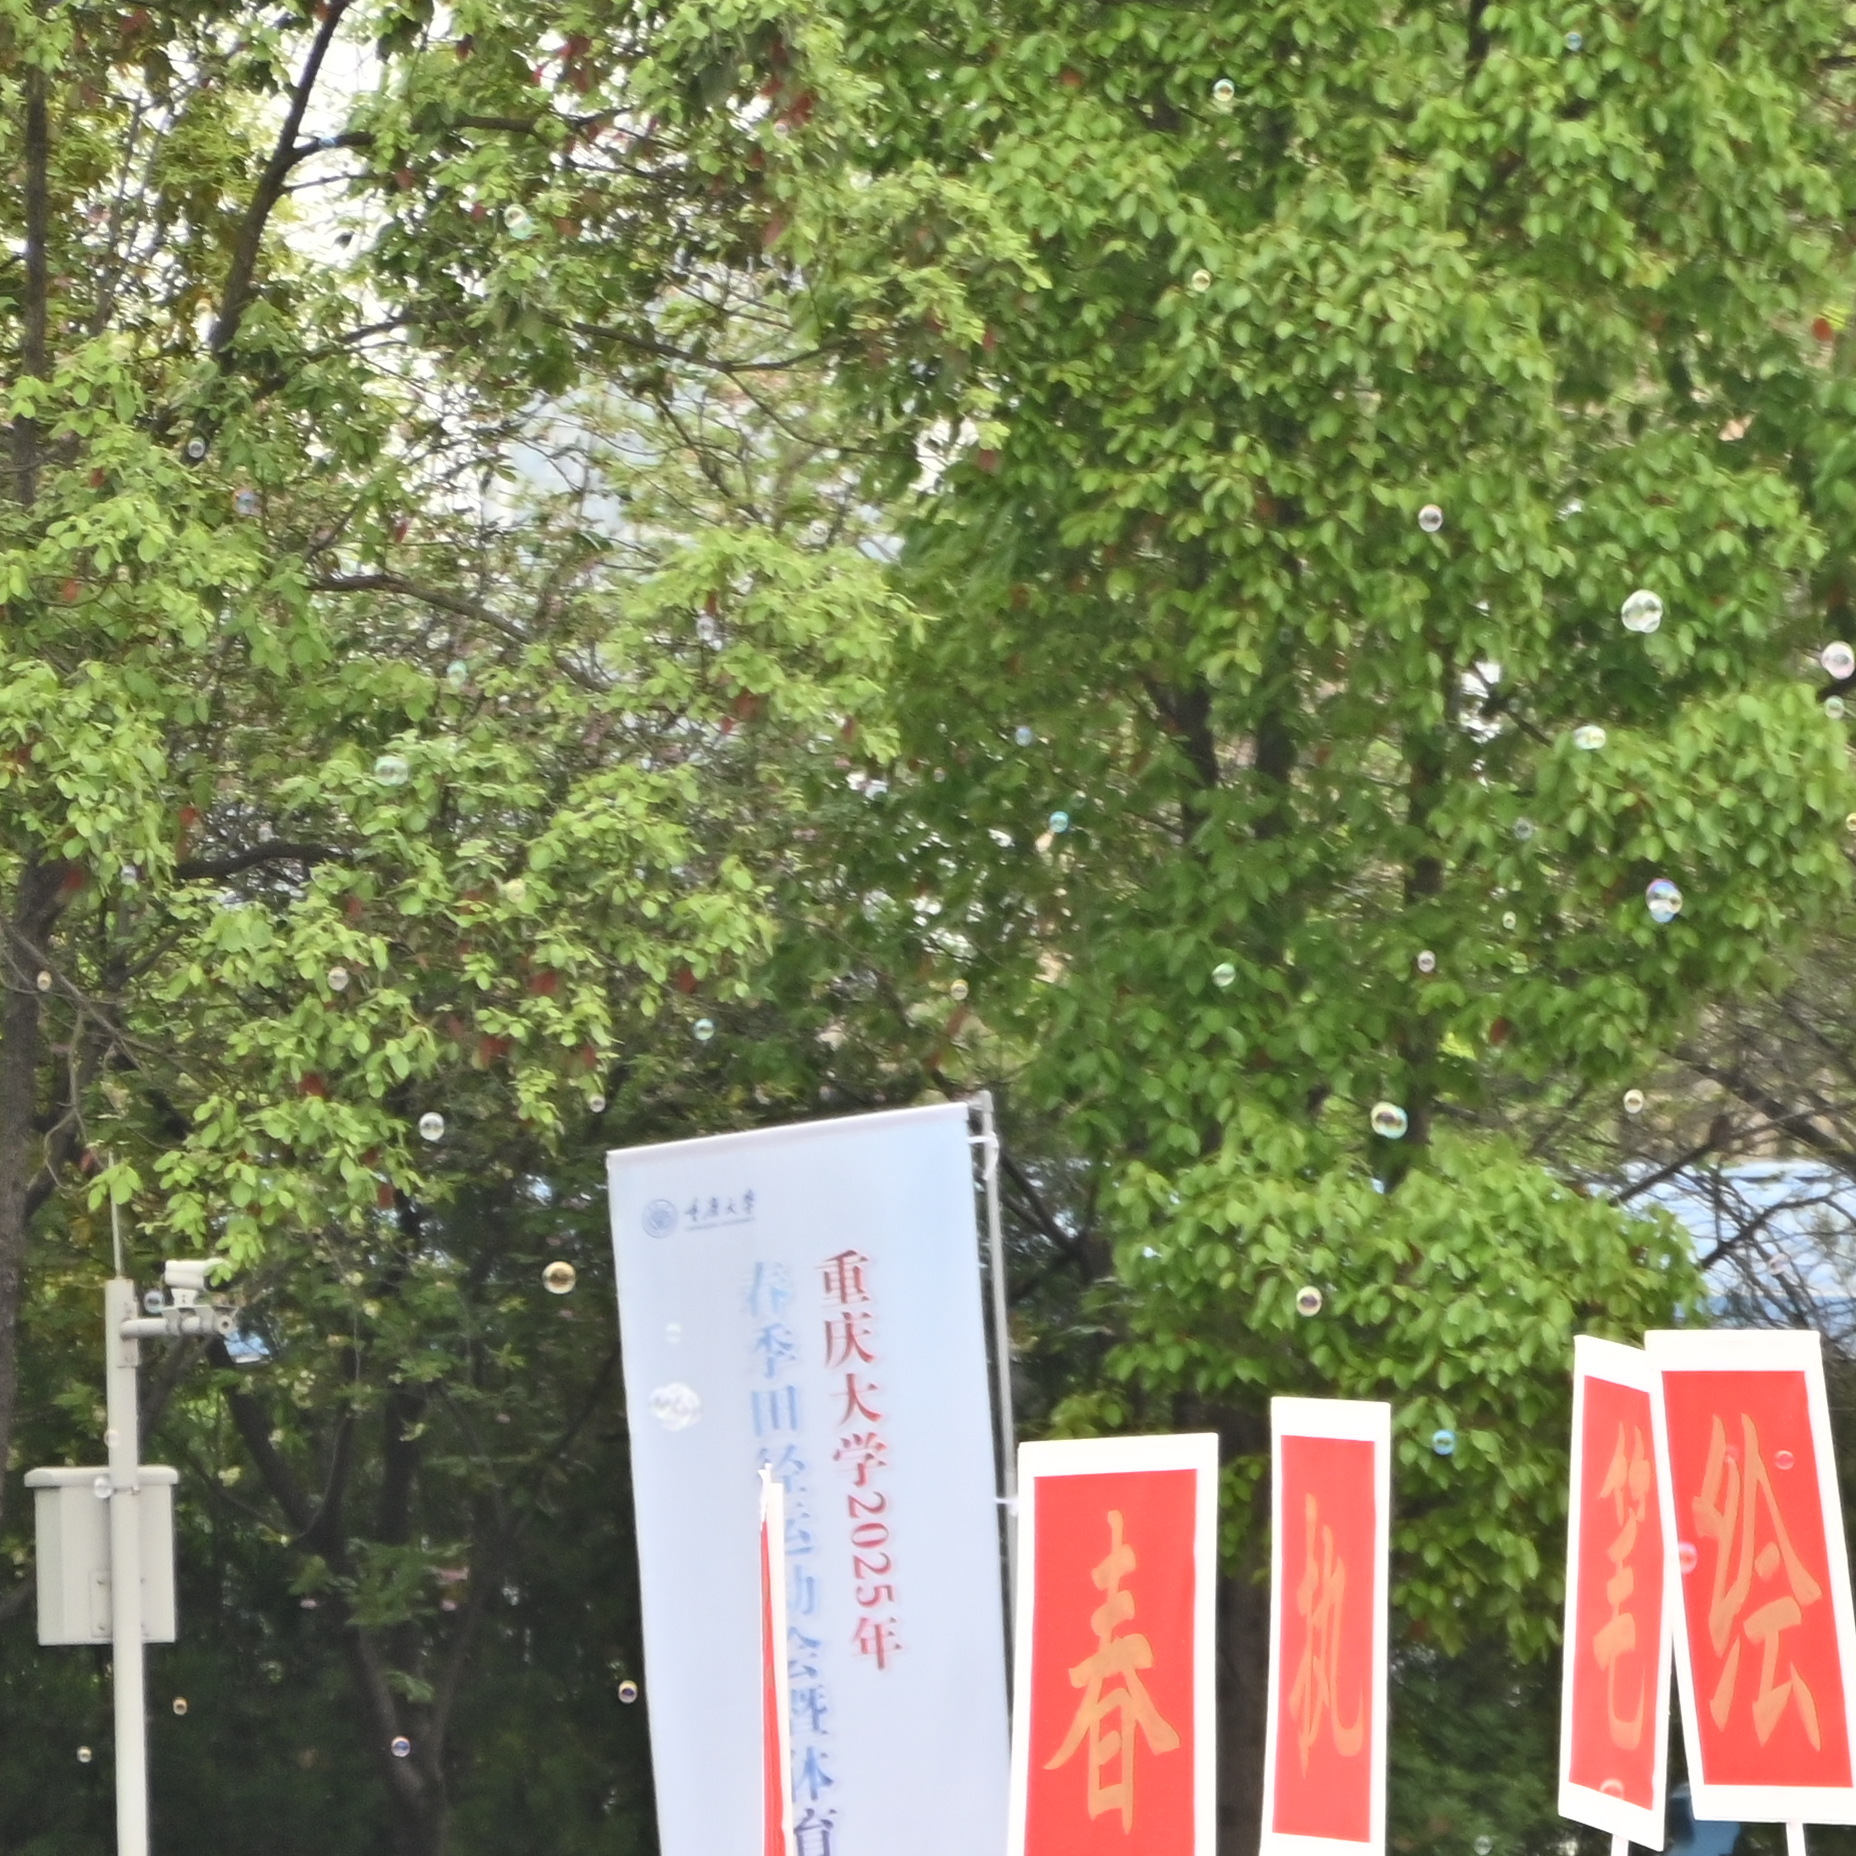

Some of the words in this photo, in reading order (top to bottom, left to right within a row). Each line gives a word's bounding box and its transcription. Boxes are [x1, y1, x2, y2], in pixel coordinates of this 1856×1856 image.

[814, 1248, 903, 1672] 重庆大学2025年
[1043, 1509, 1182, 1836] 春
